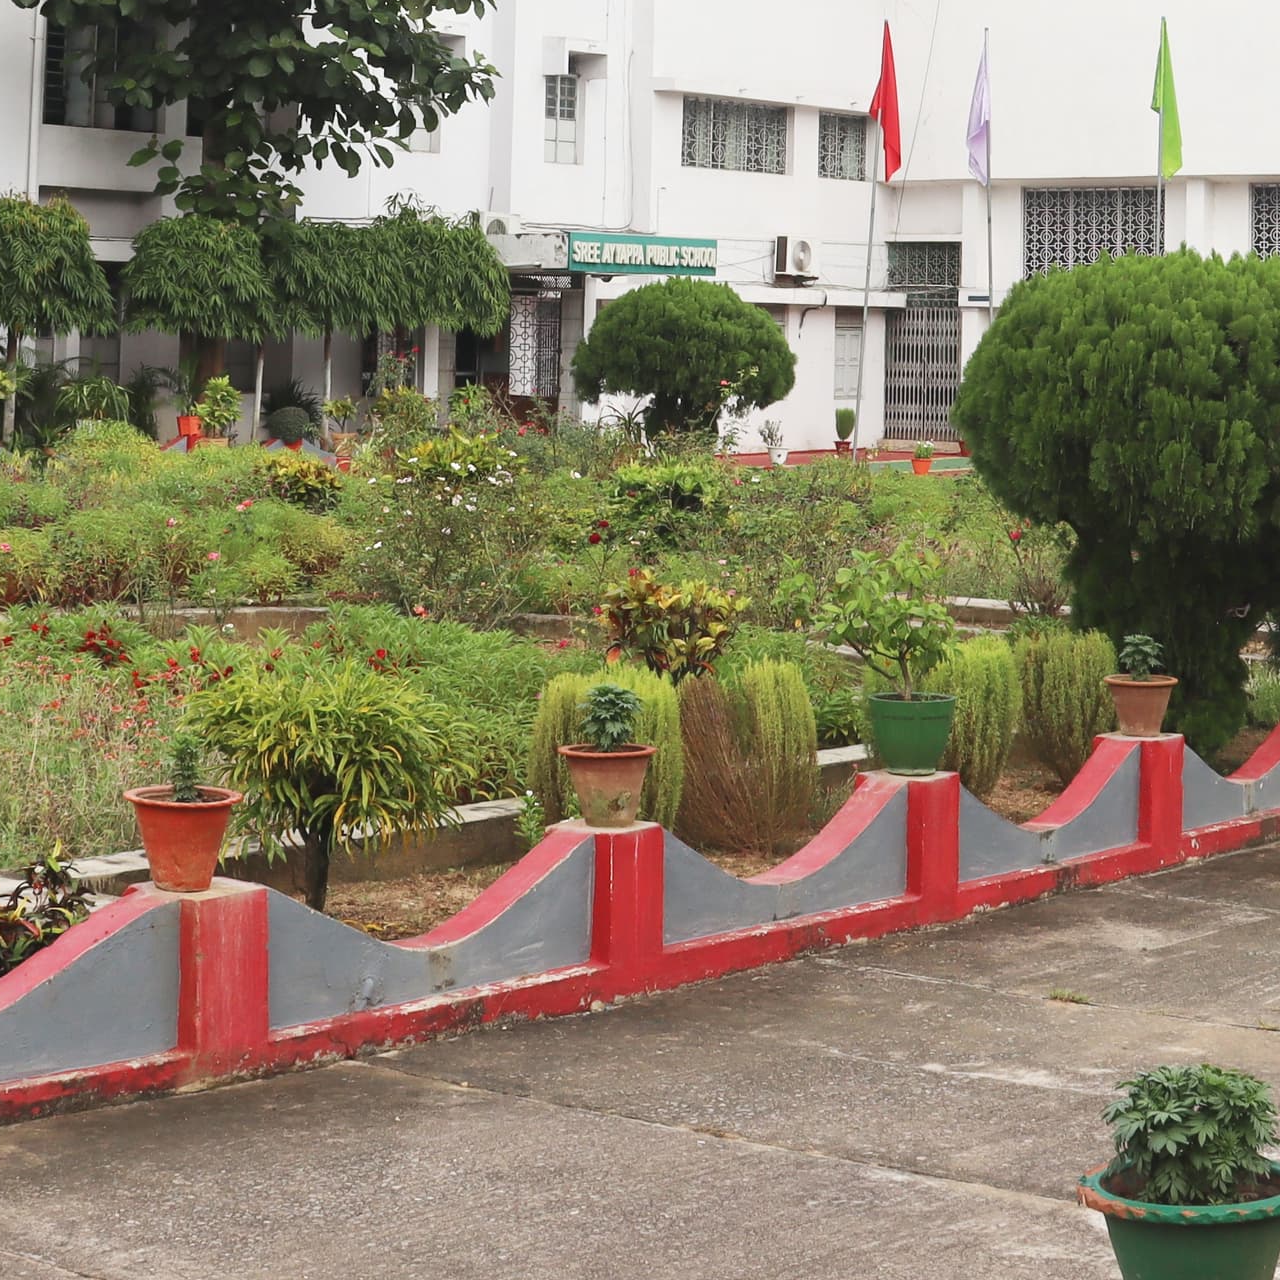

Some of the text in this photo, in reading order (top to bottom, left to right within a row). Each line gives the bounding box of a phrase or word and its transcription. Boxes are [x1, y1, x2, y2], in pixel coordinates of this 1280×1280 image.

[572, 240, 717, 268] SREE AYYAPPA PUBLIC SCHOOL
